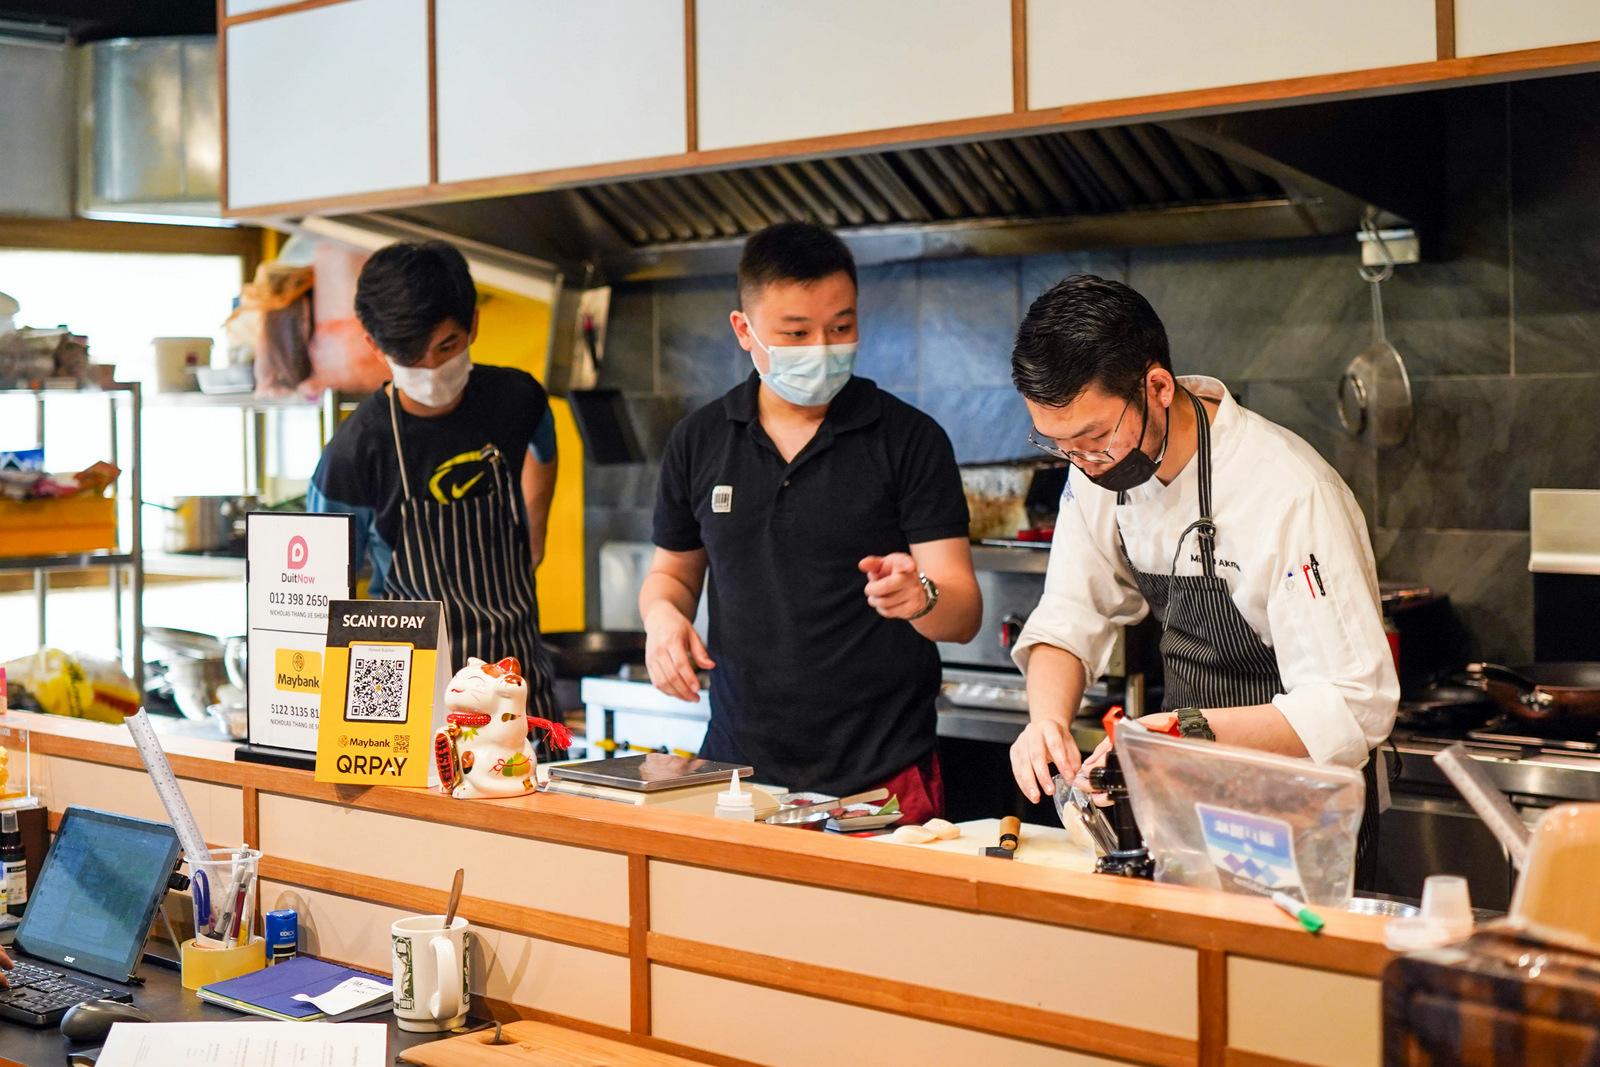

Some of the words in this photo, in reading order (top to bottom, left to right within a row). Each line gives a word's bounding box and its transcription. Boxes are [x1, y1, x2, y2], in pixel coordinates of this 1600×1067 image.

[281, 573, 315, 584] DuitNow
[269, 592, 285, 604] 012
[288, 593, 304, 606] 398
[306, 595, 328, 607] 2650
[270, 609, 291, 617] NICHOLAS
[342, 614, 378, 628] SCAN
[379, 615, 398, 628] TO
[400, 616, 426, 629] PAY
[277, 673, 320, 689] Maybank
[271, 703, 288, 715] 5122
[290, 706, 309, 718] 3135
[310, 708, 319, 718] 81
[270, 719, 292, 727] NICHOLAS
[292, 721, 308, 729] THANG
[349, 738, 391, 748] Maybank
[336, 754, 408, 776] QRPAY
[63, 955, 76, 963] acer
